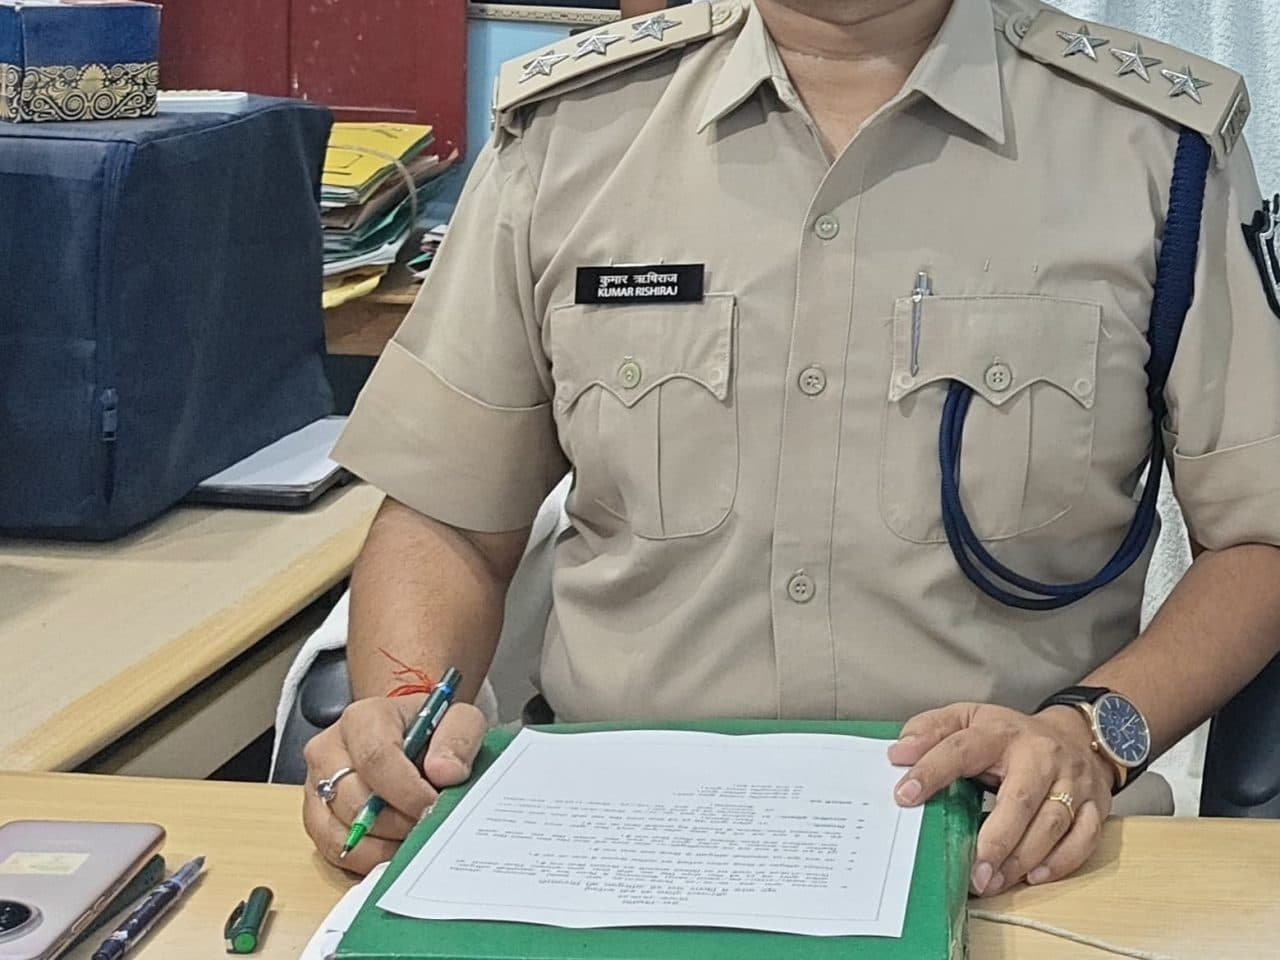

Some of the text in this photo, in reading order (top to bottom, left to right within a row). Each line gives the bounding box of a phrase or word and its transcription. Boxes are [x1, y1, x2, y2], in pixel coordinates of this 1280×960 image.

[599, 274, 629, 288] कुमार
[597, 285, 679, 298] KUMAR RISHIRAJ
